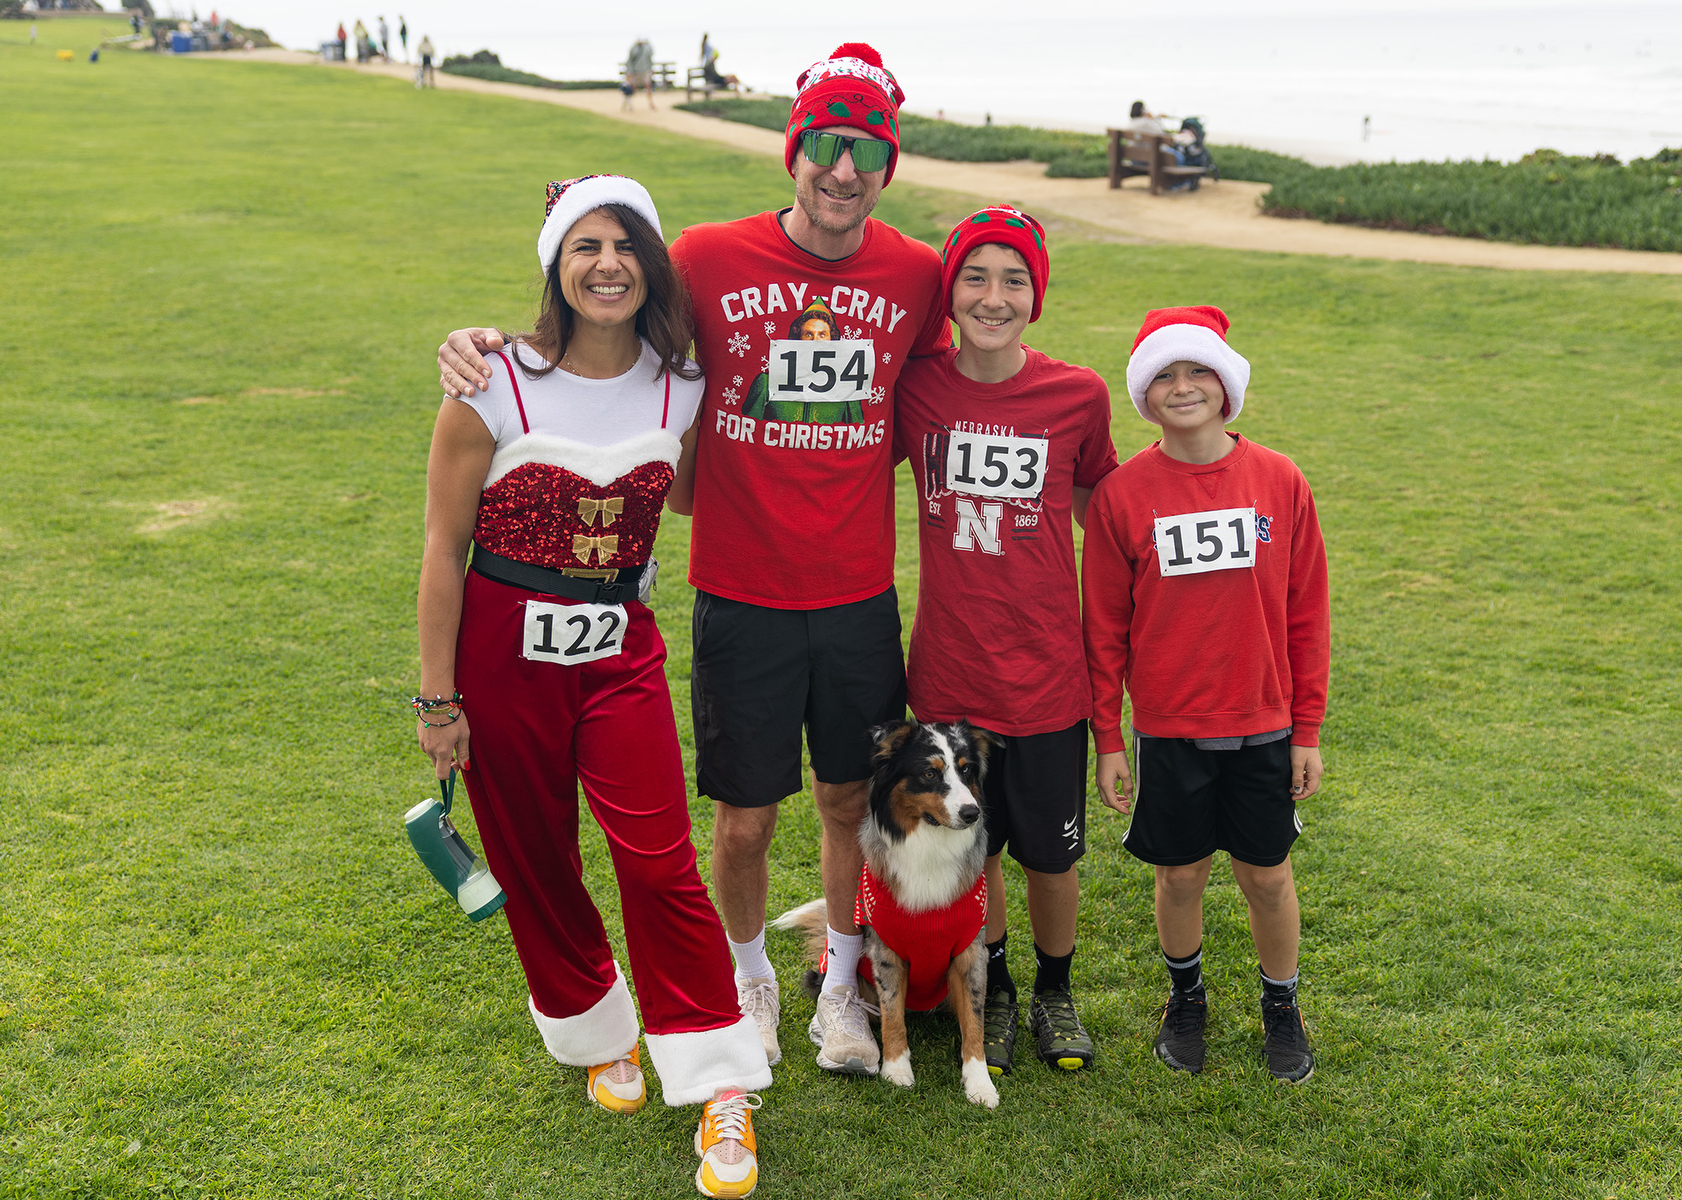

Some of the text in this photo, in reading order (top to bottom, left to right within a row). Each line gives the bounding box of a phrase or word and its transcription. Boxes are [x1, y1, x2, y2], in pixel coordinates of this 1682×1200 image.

[778, 350, 869, 393] 154
[716, 409, 885, 450] FOR CHRISTMAS
[955, 420, 1015, 437] NEBRASKA
[954, 442, 1039, 489] 153
[928, 501, 941, 516] EST.
[952, 497, 1004, 556] N
[1014, 514, 1038, 527] 1869
[1165, 518, 1250, 567] 151
[533, 610, 620, 656] 122
